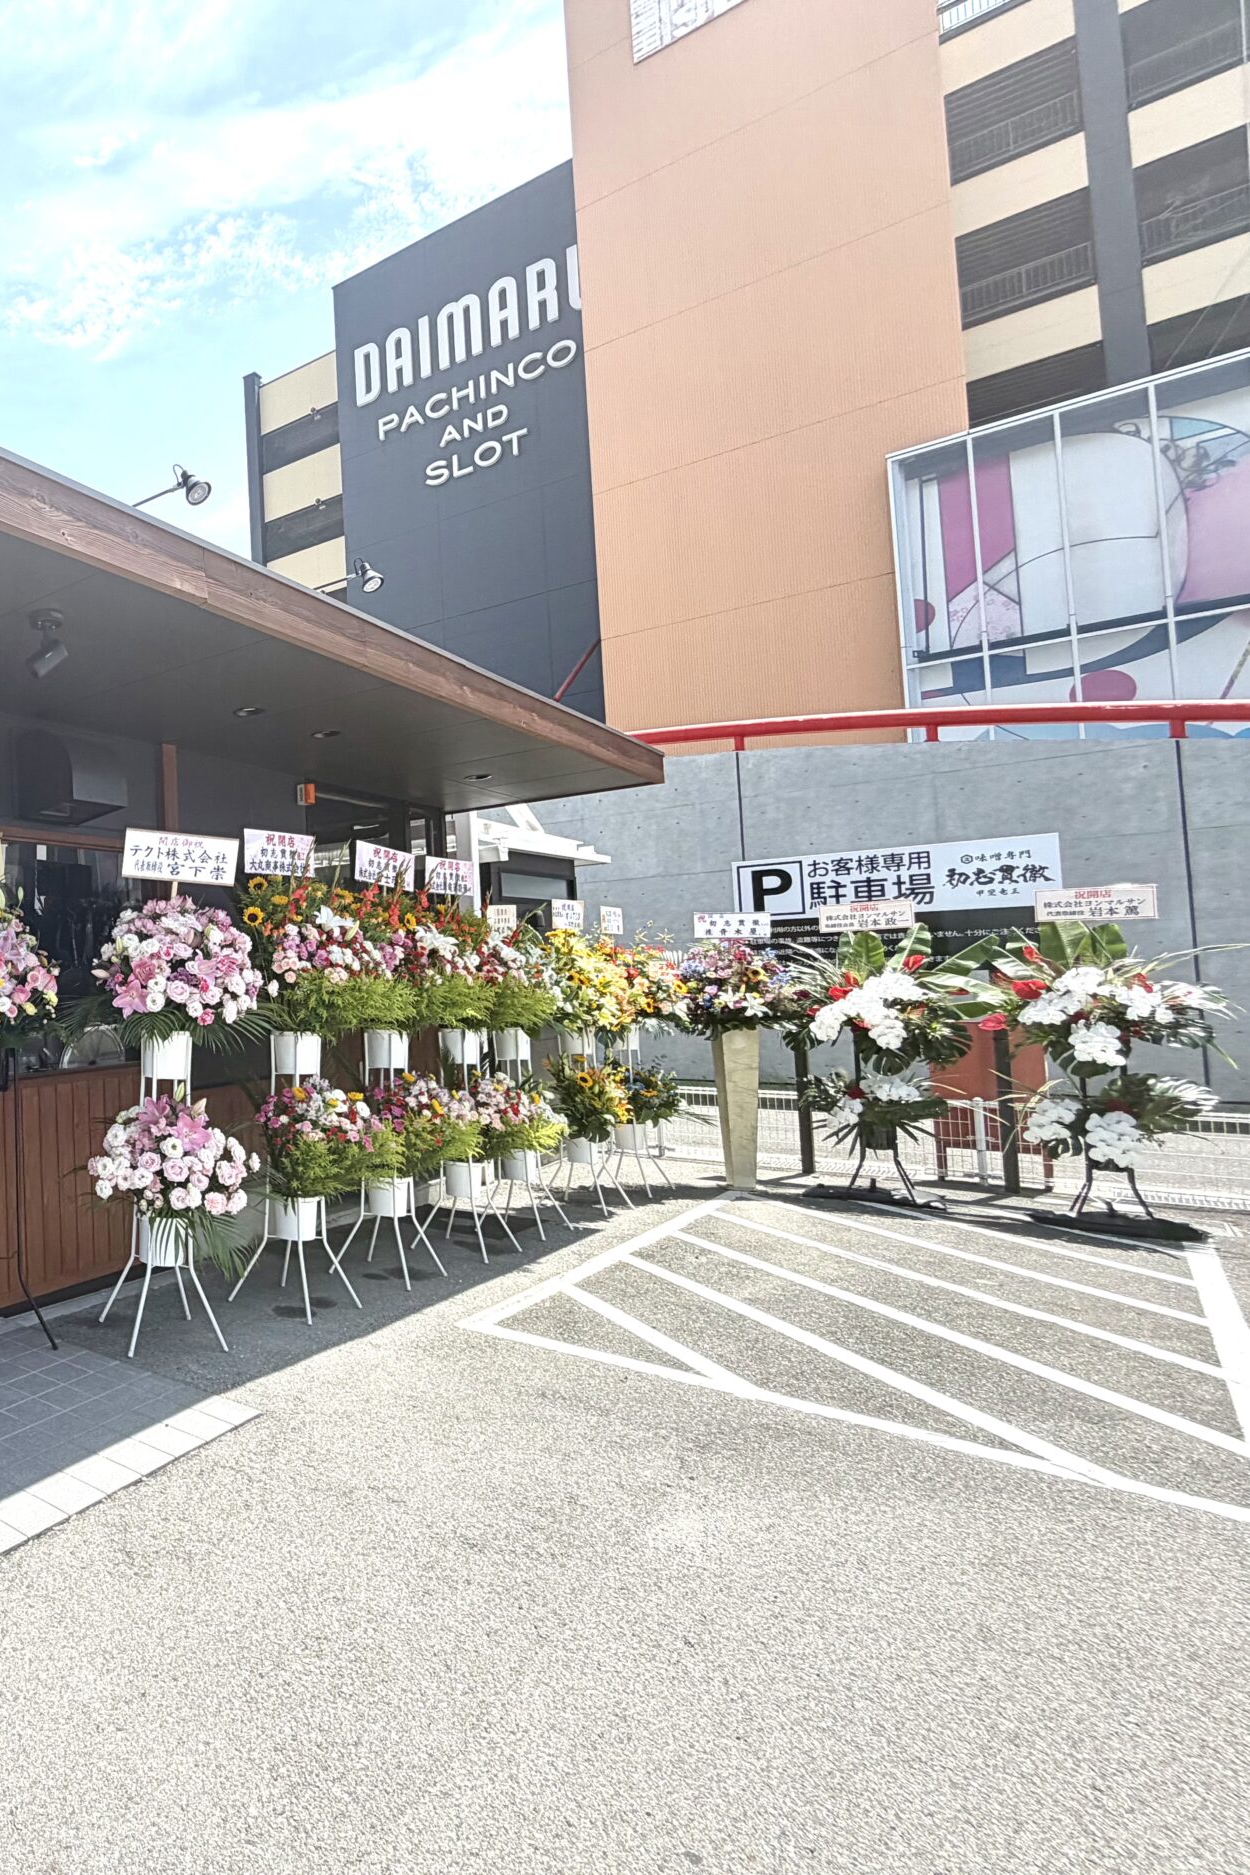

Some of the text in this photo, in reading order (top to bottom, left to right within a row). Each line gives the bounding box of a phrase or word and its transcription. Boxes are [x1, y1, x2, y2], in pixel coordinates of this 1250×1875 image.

[377, 339, 577, 441] PACHINCO
[439, 404, 509, 447] AND
[424, 428, 528, 486] SLOT
[265, 833, 295, 848] 祝開店
[130, 845, 228, 864] テクト株式会社
[807, 851, 931, 878] お客様専用
[975, 849, 1032, 862] 味噌専門
[942, 864, 1056, 889] 初志貫徹
[751, 868, 793, 911] P
[809, 873, 936, 910] 駐車場
[1074, 890, 1112, 899] 祝開店
[850, 904, 878, 913] 祝開店
[1044, 898, 1146, 908] 株式会社ヨンマルサン
